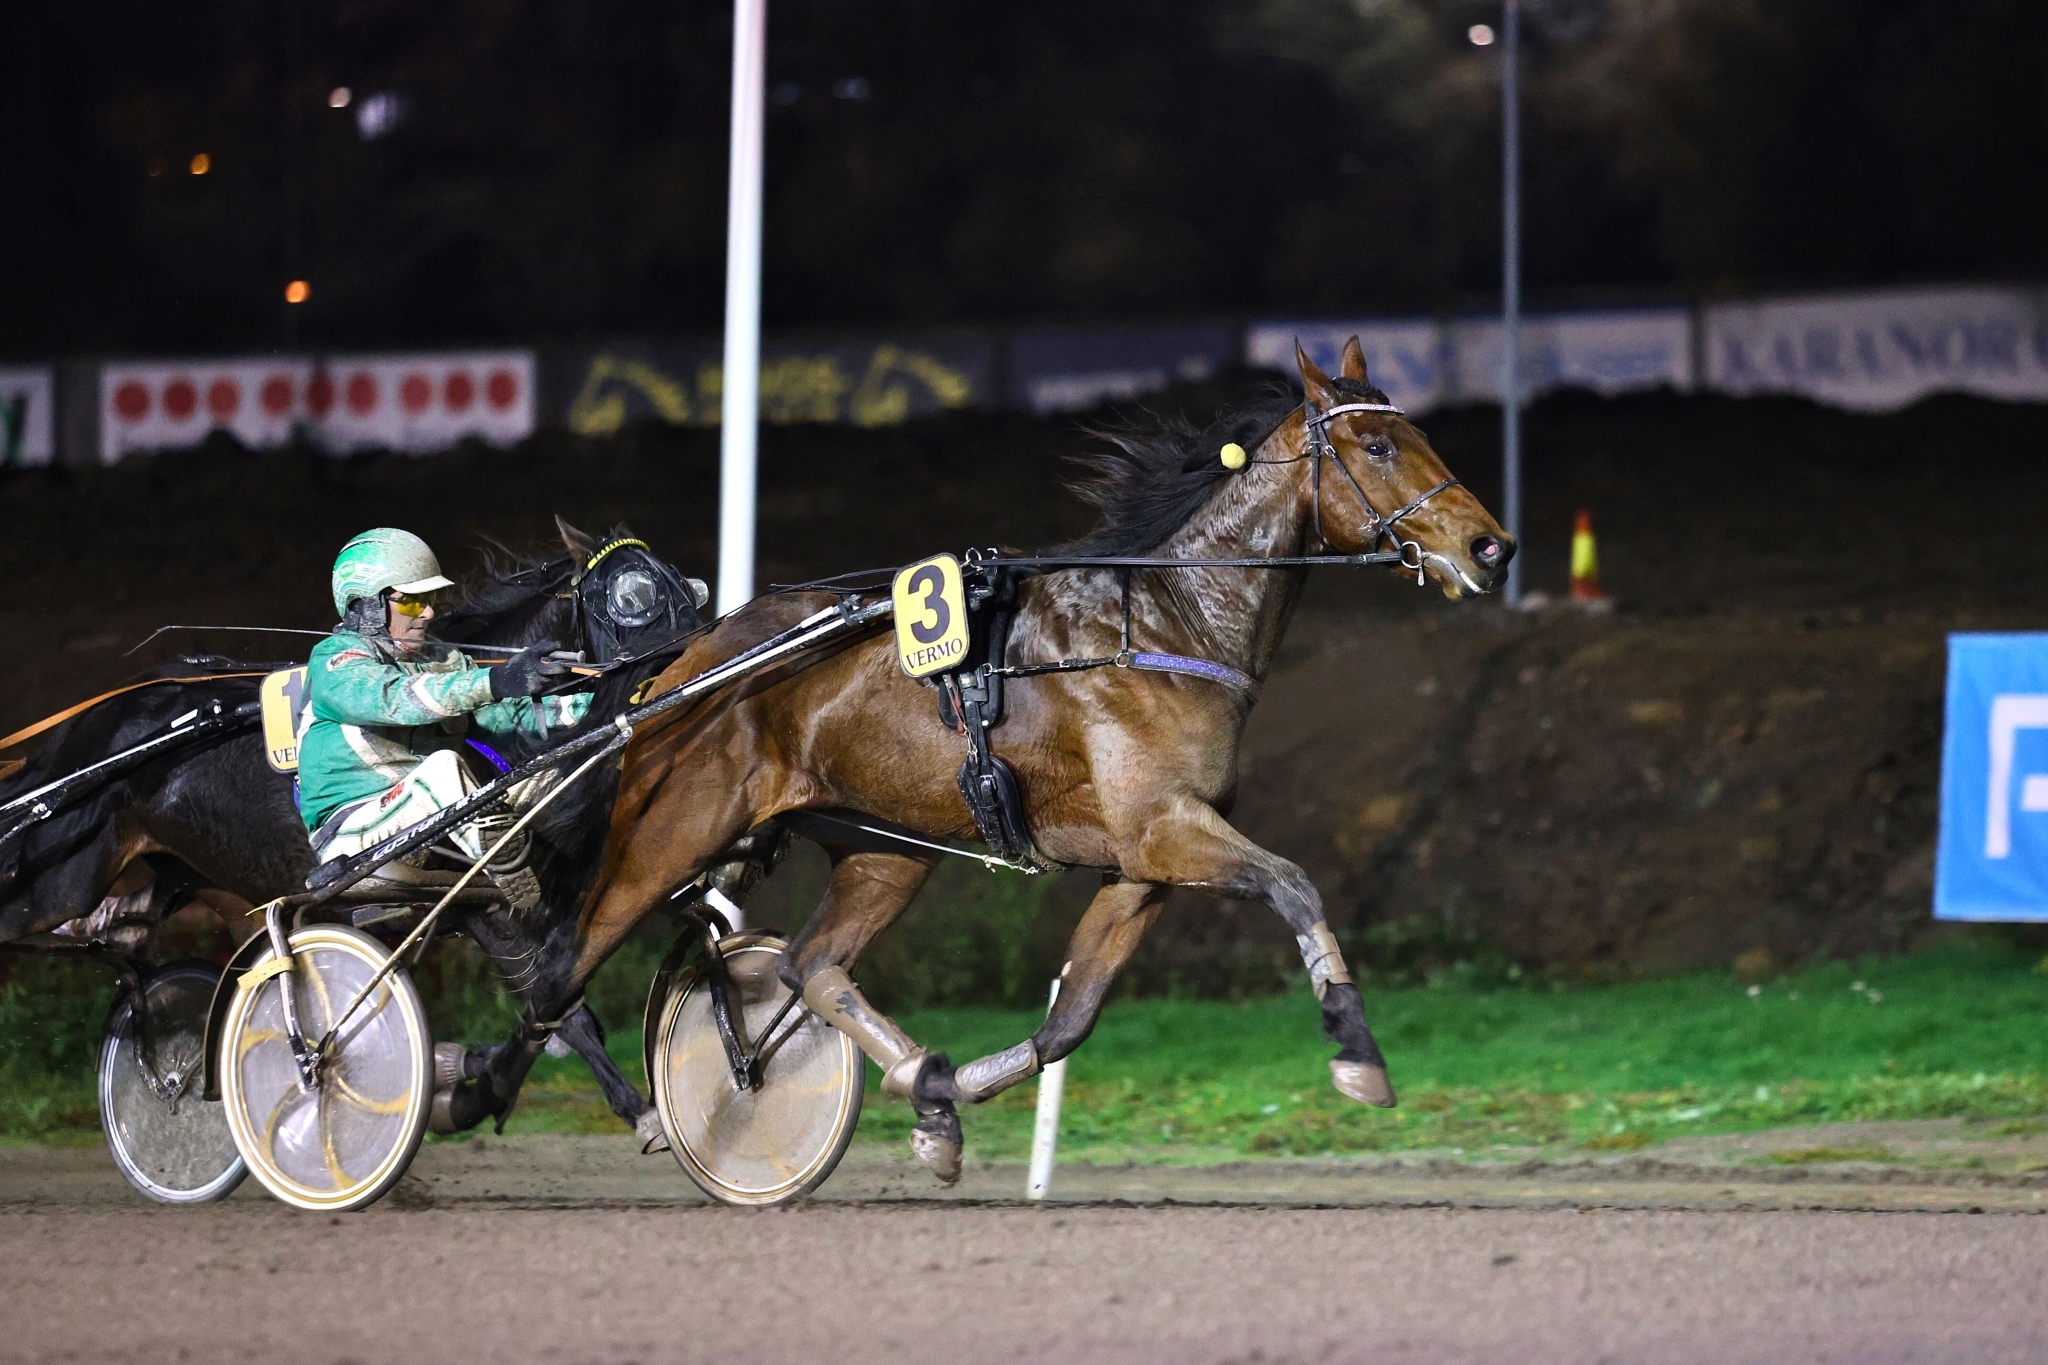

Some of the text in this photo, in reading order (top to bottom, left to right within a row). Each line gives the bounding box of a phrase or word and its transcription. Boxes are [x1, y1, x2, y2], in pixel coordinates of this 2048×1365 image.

[908, 565, 950, 644] 3
[906, 638, 963, 669] VERMO
[282, 670, 303, 739] 1
[273, 745, 297, 764] VE
